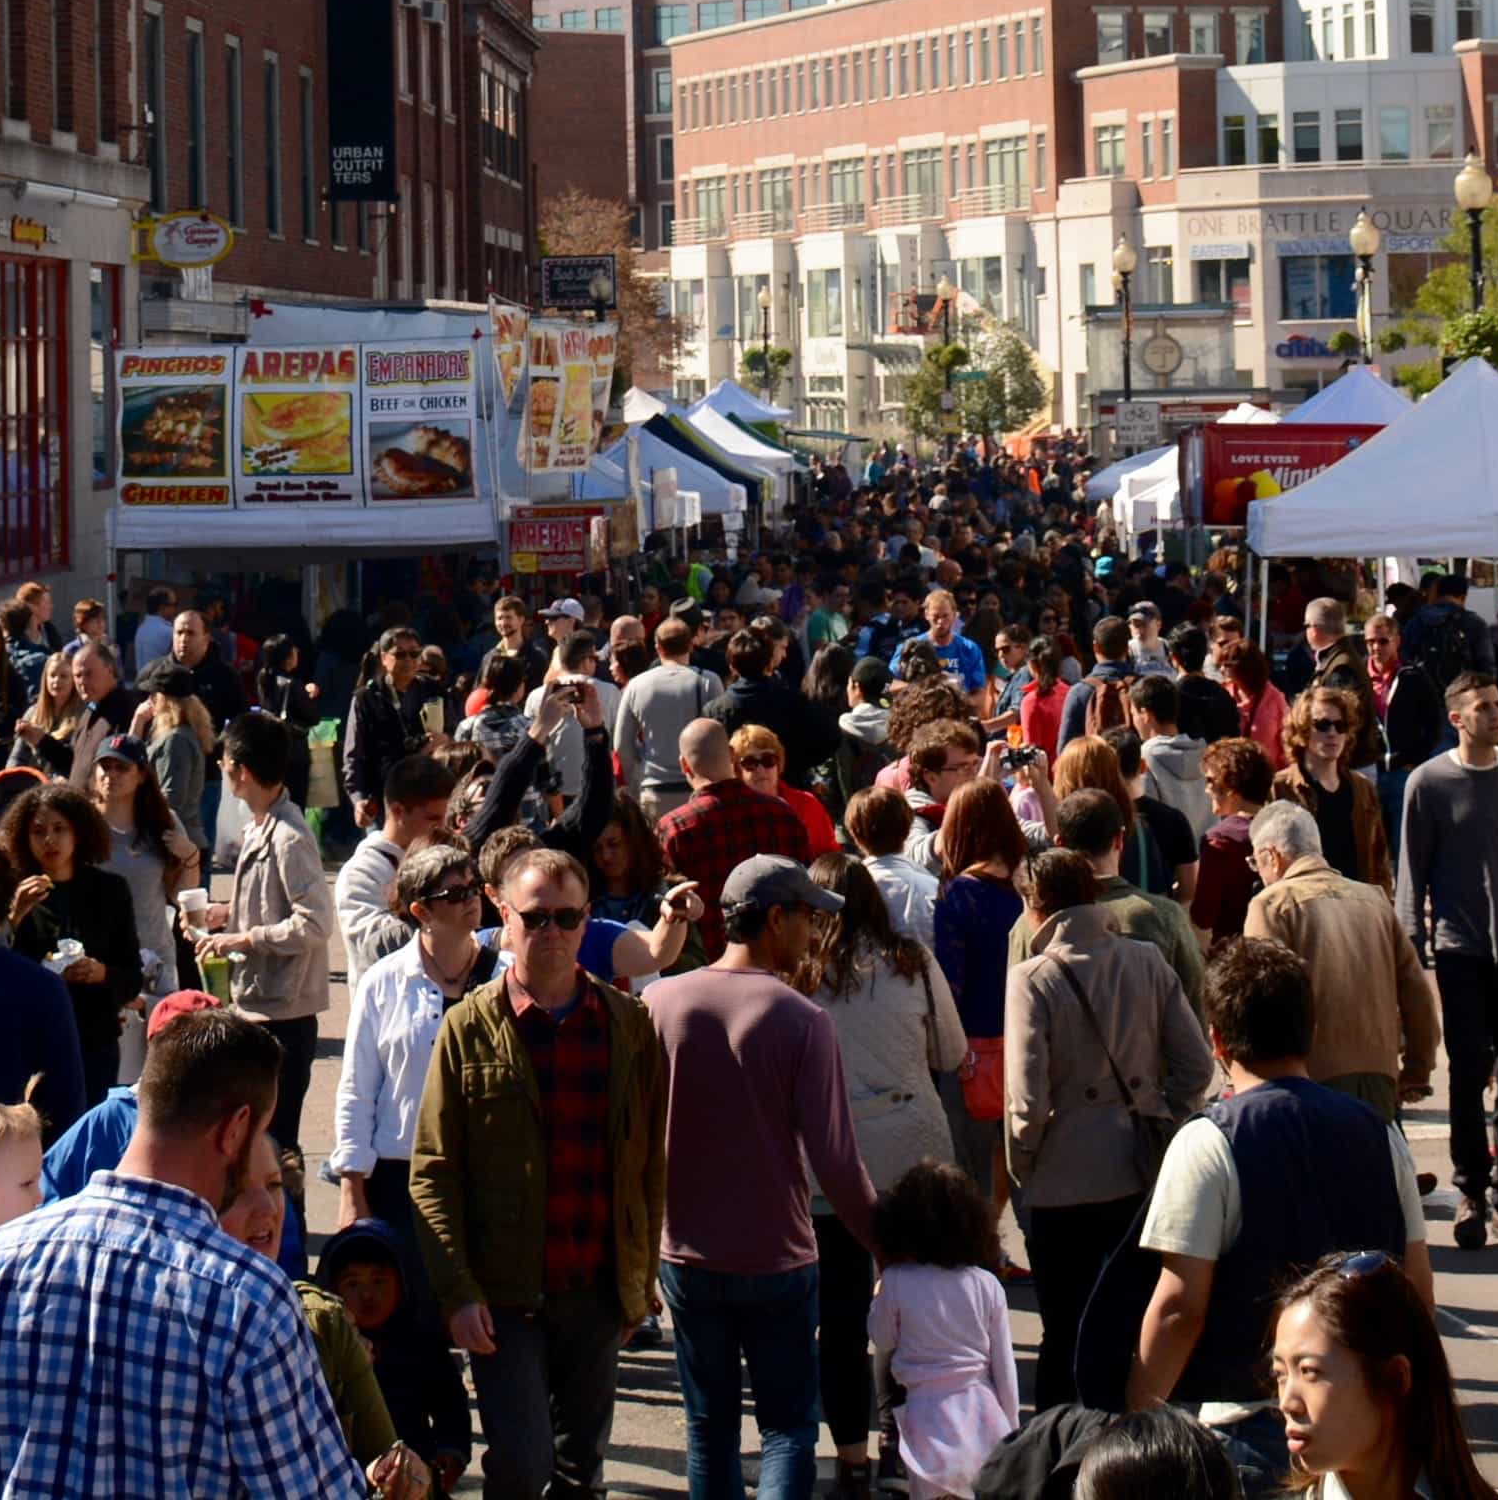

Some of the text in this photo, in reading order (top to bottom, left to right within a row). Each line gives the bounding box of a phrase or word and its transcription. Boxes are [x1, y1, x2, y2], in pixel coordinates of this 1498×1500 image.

[332, 147, 384, 158] URBAN
[332, 159, 384, 171] OUTFIT
[333, 172, 373, 184] TERS
[1187, 217, 1228, 237] ONE
[1237, 211, 1338, 235] BRATTLE
[240, 350, 356, 383] AREPAS
[366, 350, 472, 386] EMPANADAS
[370, 396, 399, 412] BEEF
[419, 395, 468, 411] CHICKEN
[1231, 454, 1300, 464] LOVE EVERY
[121, 484, 230, 506] CHICKEN
